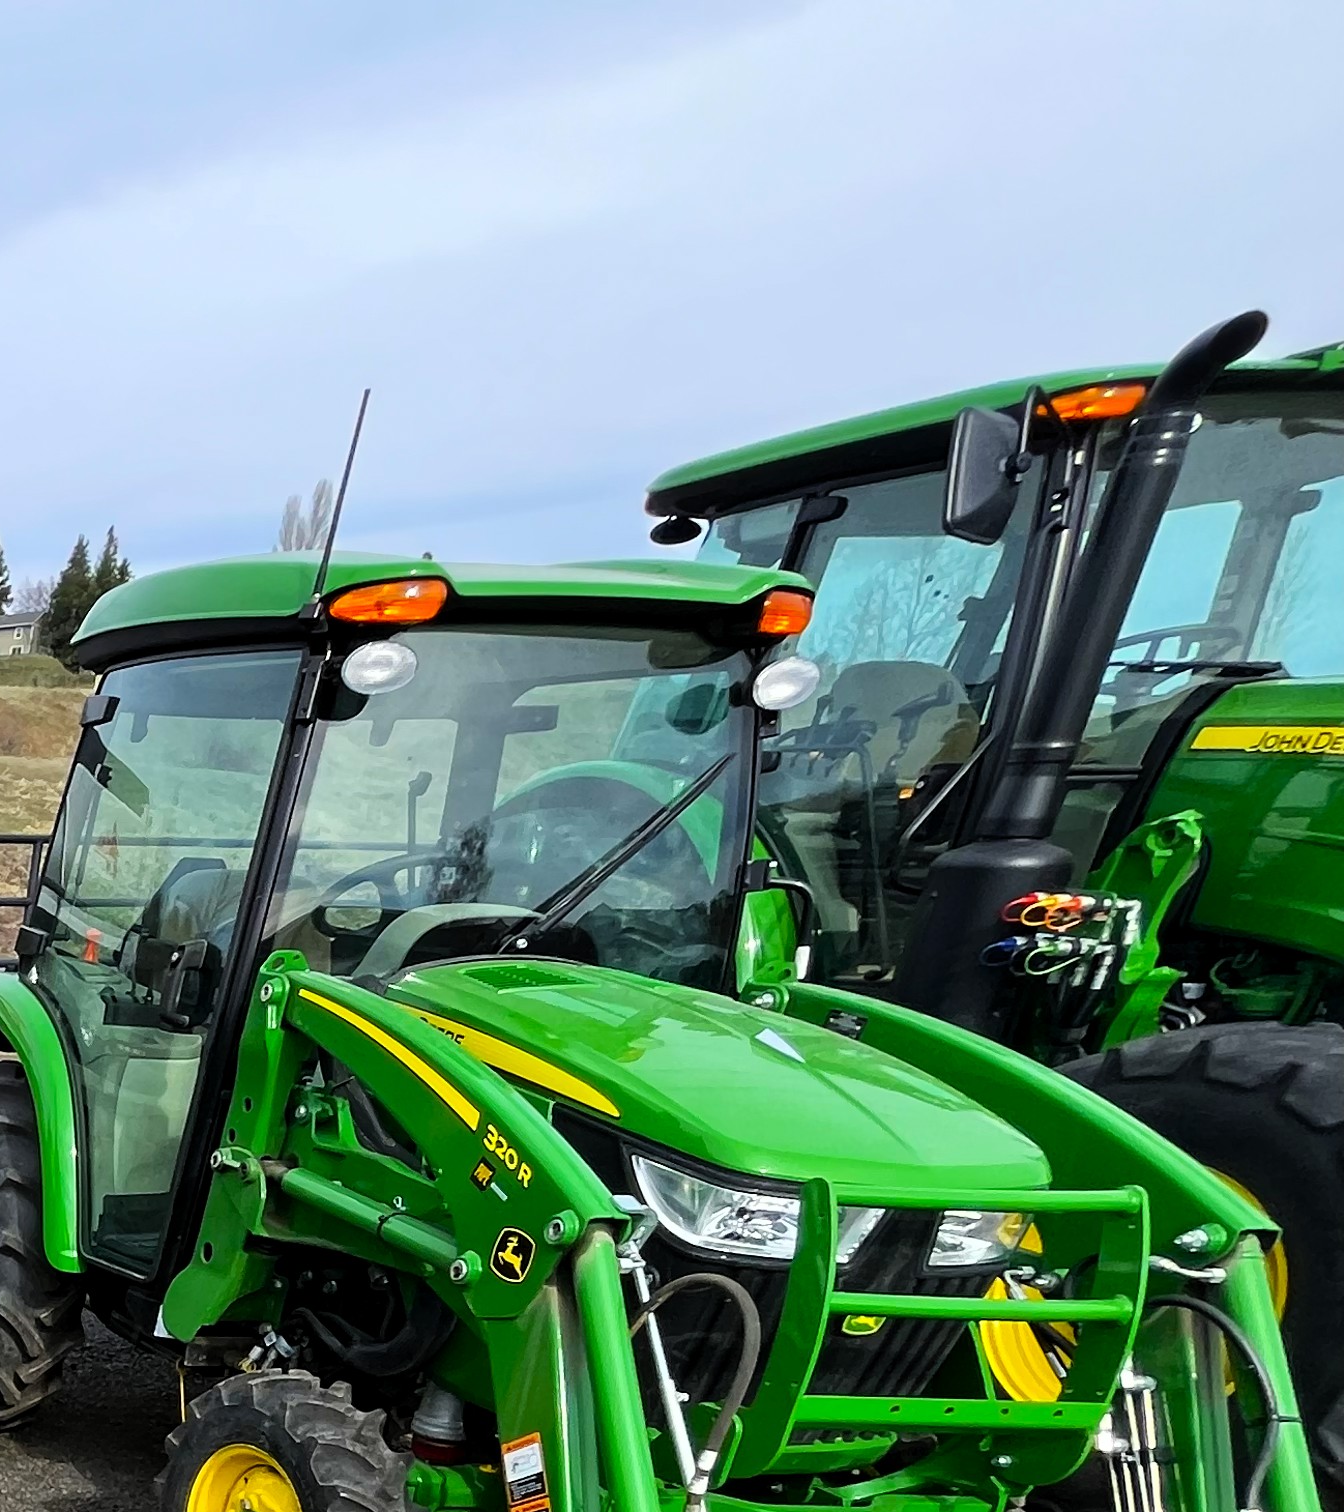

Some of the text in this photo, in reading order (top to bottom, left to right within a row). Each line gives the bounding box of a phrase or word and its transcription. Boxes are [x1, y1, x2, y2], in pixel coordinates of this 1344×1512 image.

[1250, 732, 1313, 750] JOHN
[483, 1124, 518, 1170] 320
[517, 1161, 532, 1189] R
